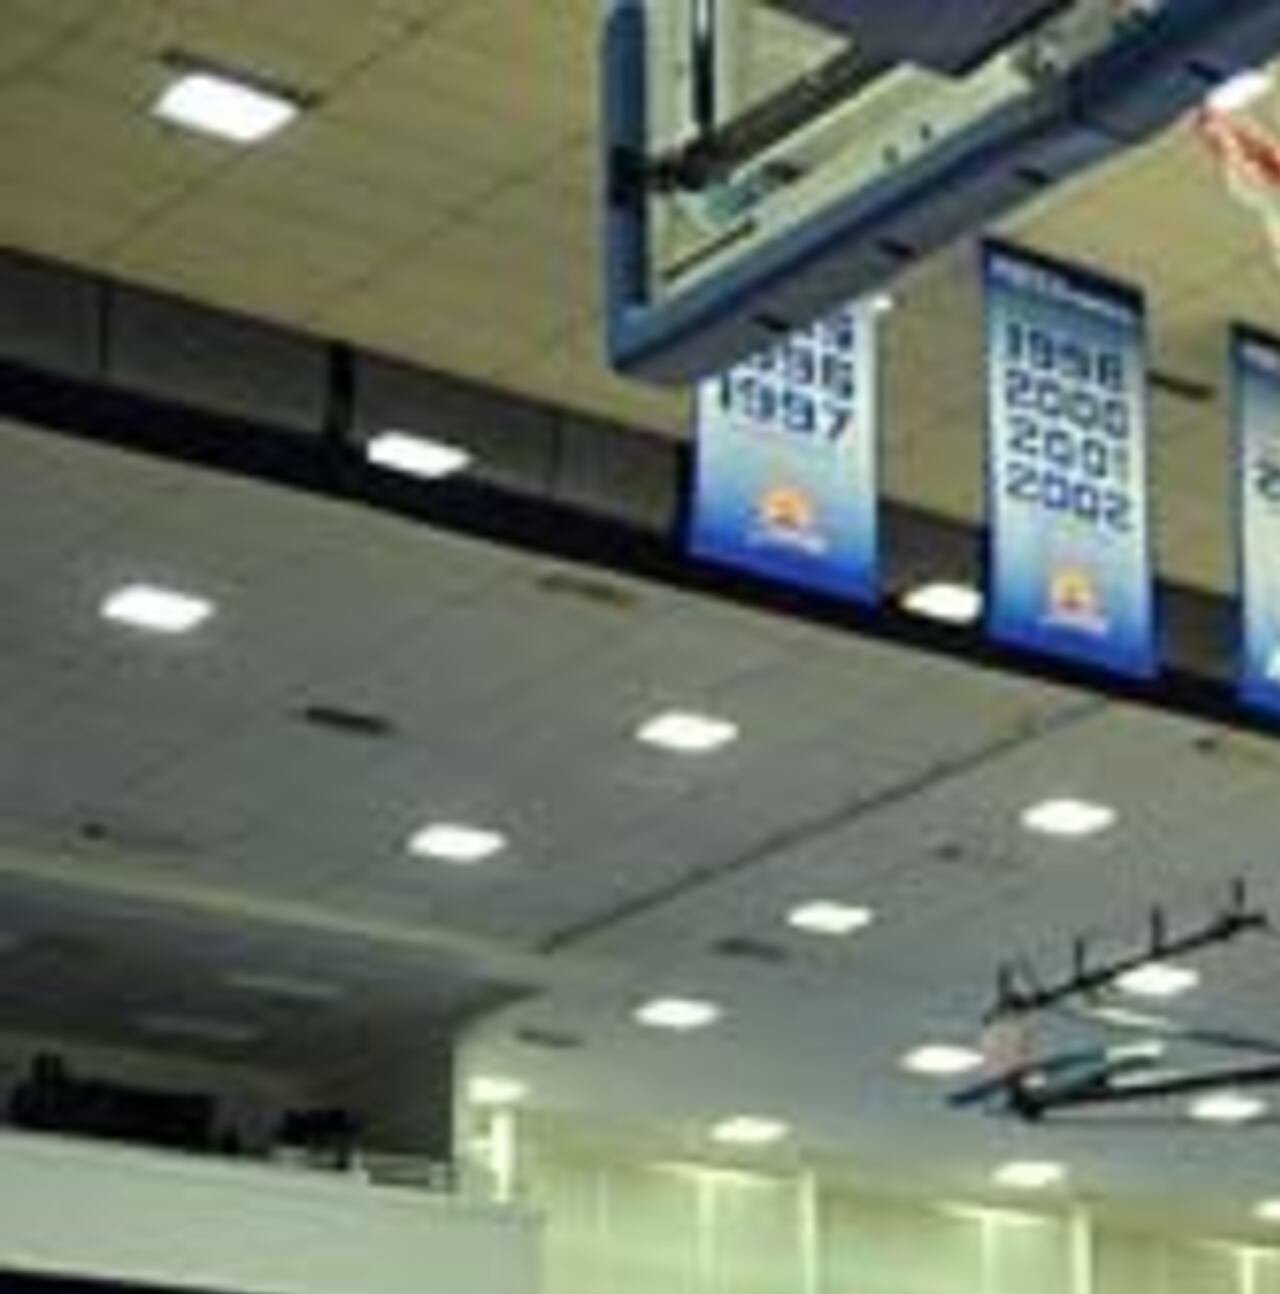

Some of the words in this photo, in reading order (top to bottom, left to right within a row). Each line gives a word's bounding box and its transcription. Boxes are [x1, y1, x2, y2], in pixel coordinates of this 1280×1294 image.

[719, 369, 852, 442] 1997
[1006, 368, 1130, 440] 2000
[1006, 460, 1134, 534] 2002
